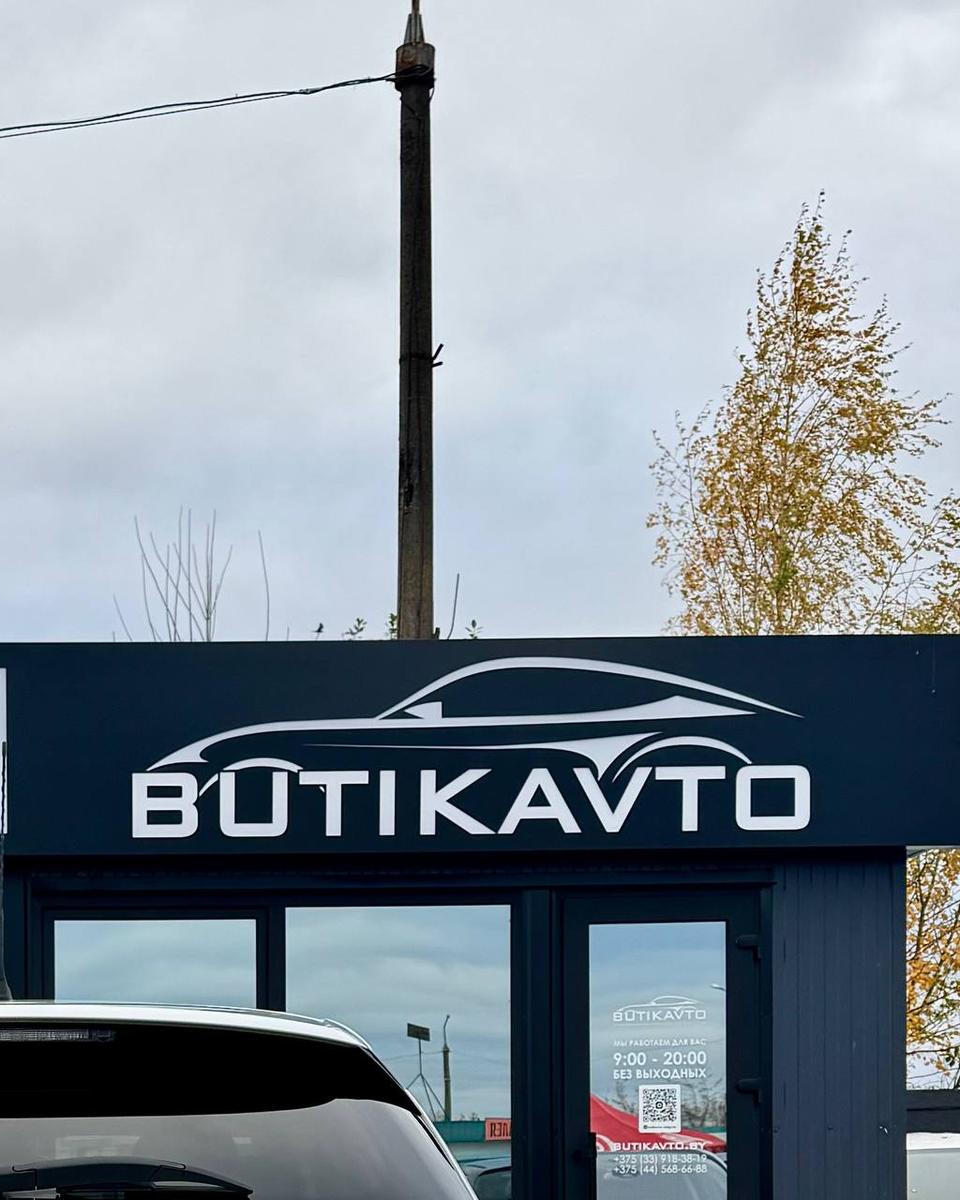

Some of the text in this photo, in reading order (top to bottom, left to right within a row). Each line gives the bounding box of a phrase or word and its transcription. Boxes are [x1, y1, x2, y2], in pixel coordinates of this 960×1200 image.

[131, 765, 810, 838] BUTIKAVTO
[613, 1009, 706, 1022] BUTIKAVTO
[628, 1038, 670, 1047] РАБОТАЕМ
[613, 1052, 646, 1066] 9:00
[663, 1051, 707, 1065] 20:00
[613, 1068, 706, 1080] БЕЗ ВЫХОДНЫХ
[614, 1142, 706, 1151] BUTIKAVTO.BY
[613, 1154, 708, 1165] +375 (33) 918-38-19
[613, 1164, 708, 1175] +375 (44) 568-66-88
